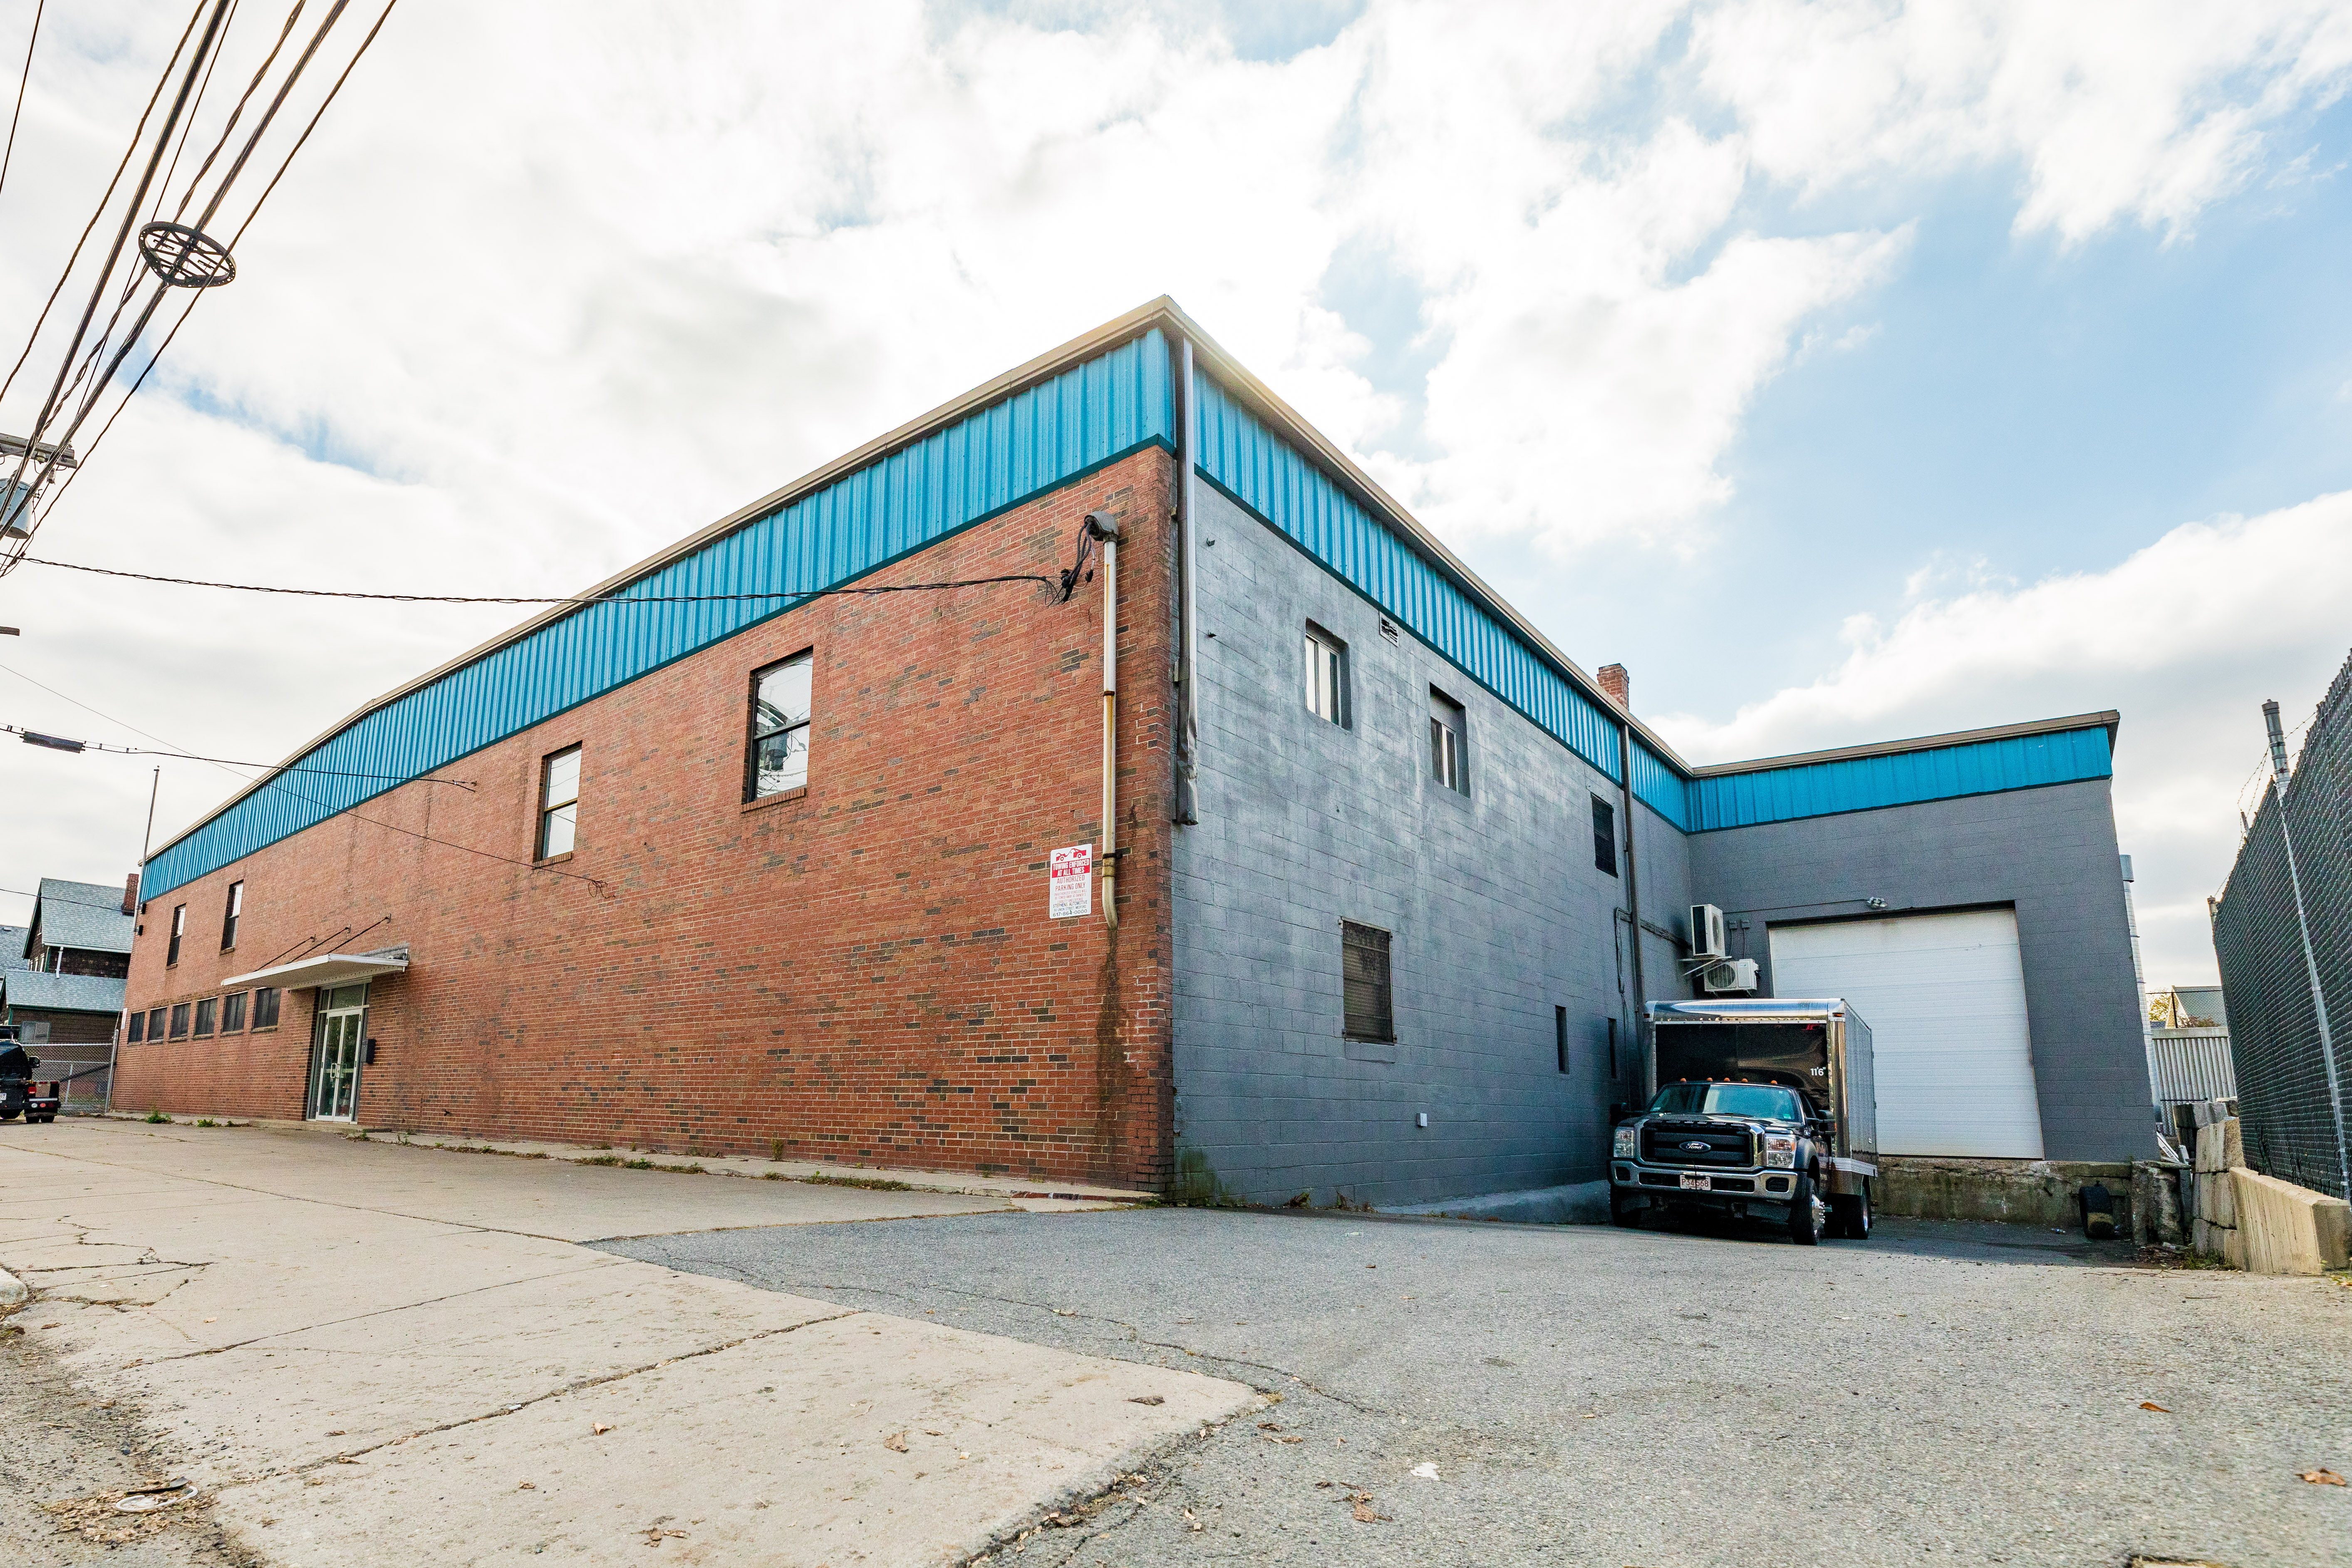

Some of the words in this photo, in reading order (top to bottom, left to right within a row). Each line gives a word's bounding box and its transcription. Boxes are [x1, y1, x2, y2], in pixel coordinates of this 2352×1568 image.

[1053, 862, 1068, 870] TOWING
[1069, 859, 1089, 868] ENFORCED
[1057, 874, 1085, 884] AUTHORIZED
